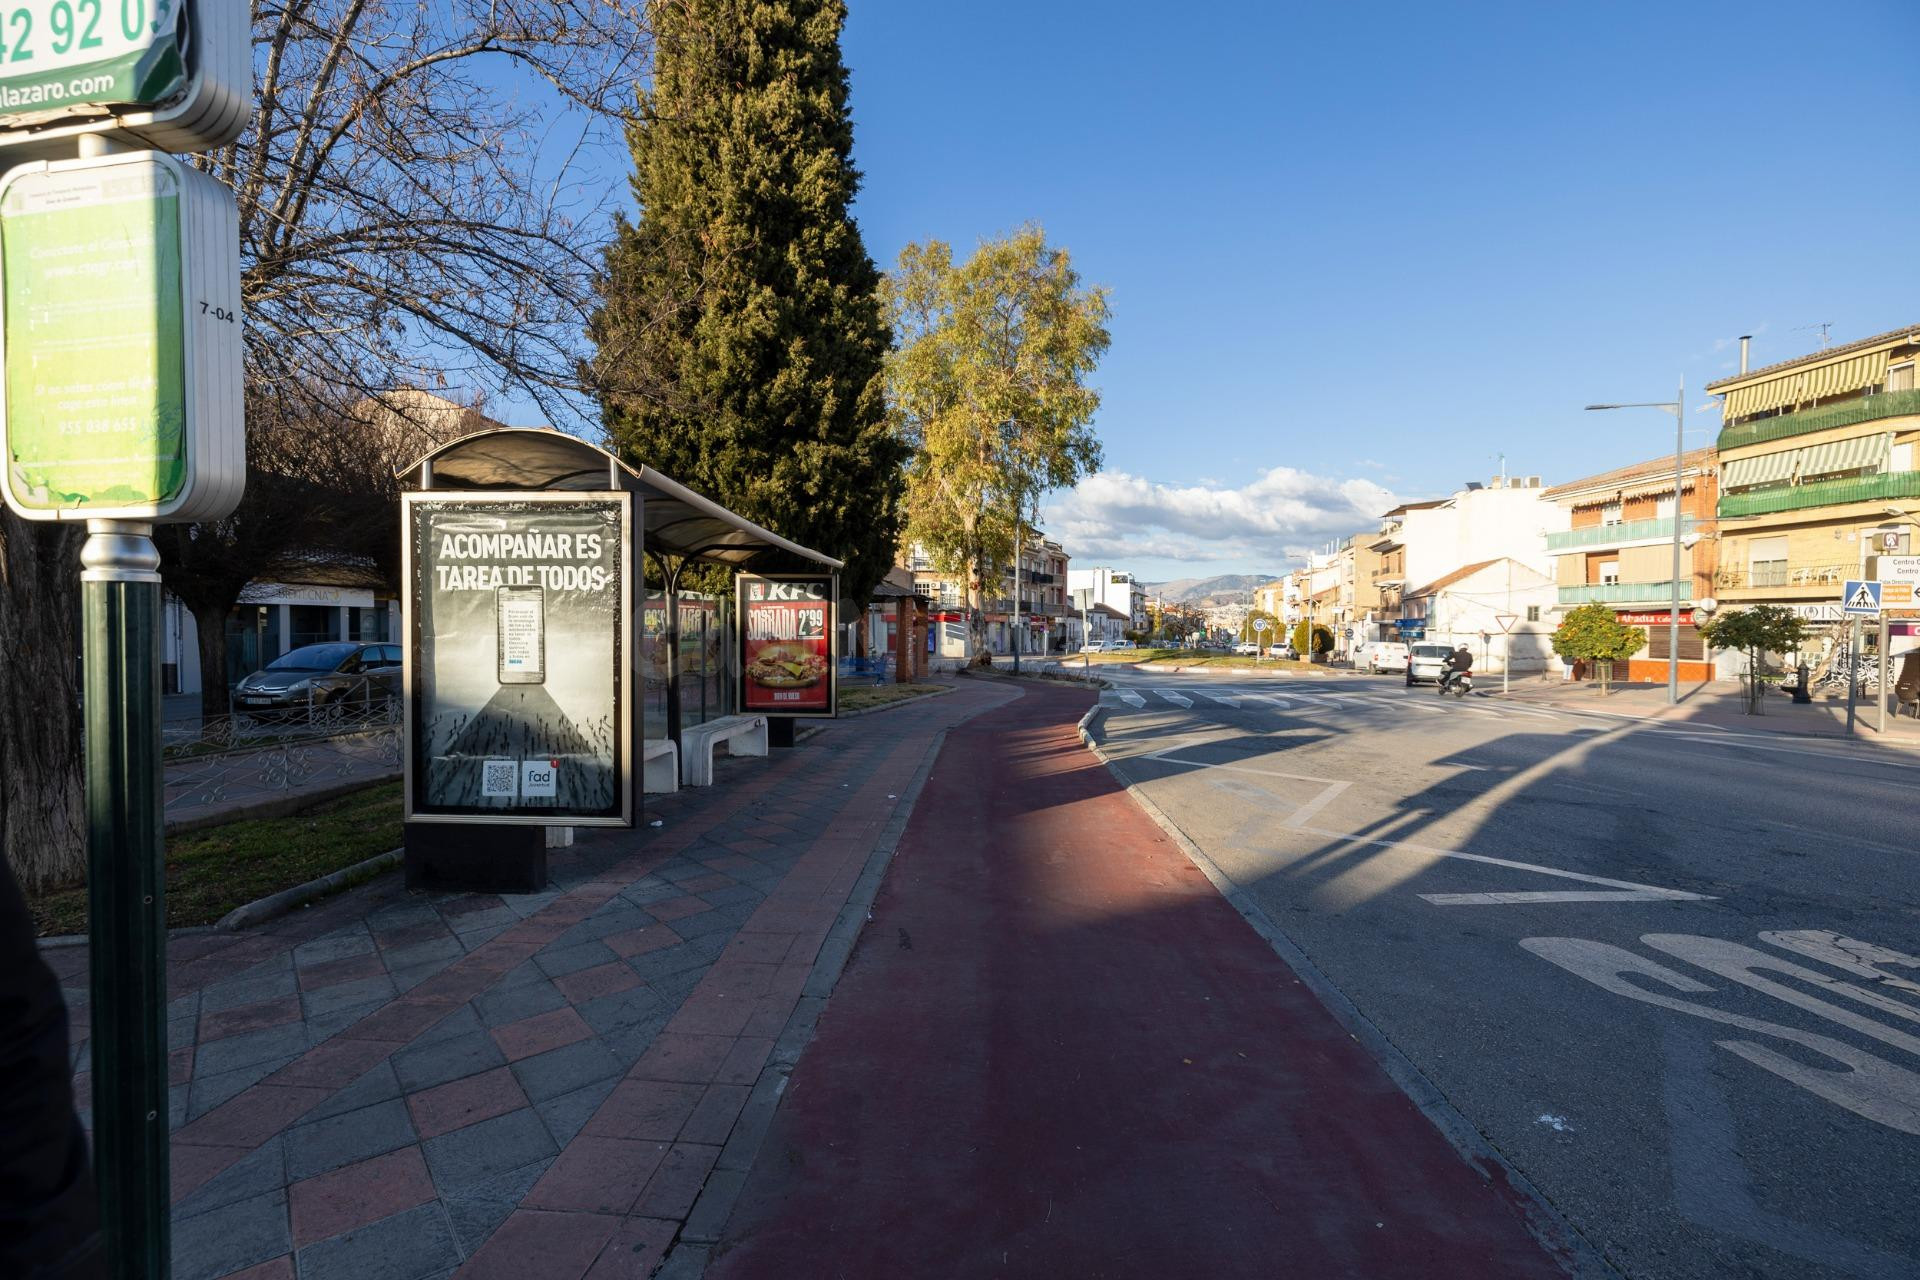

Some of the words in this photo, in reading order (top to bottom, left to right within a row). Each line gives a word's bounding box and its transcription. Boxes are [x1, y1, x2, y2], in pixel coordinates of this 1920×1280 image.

[50, 0, 103, 54] 92
[0, 75, 115, 108] lazaro.com
[200, 301, 234, 323] 7-04
[439, 529, 573, 559] ACOMPAÑAR
[576, 534, 602, 559] ES
[436, 565, 504, 591] TAREA
[537, 565, 605, 591] TODOS
[767, 583, 823, 600] KFC
[799, 609, 823, 636] 2'99
[528, 770, 551, 782] fad
